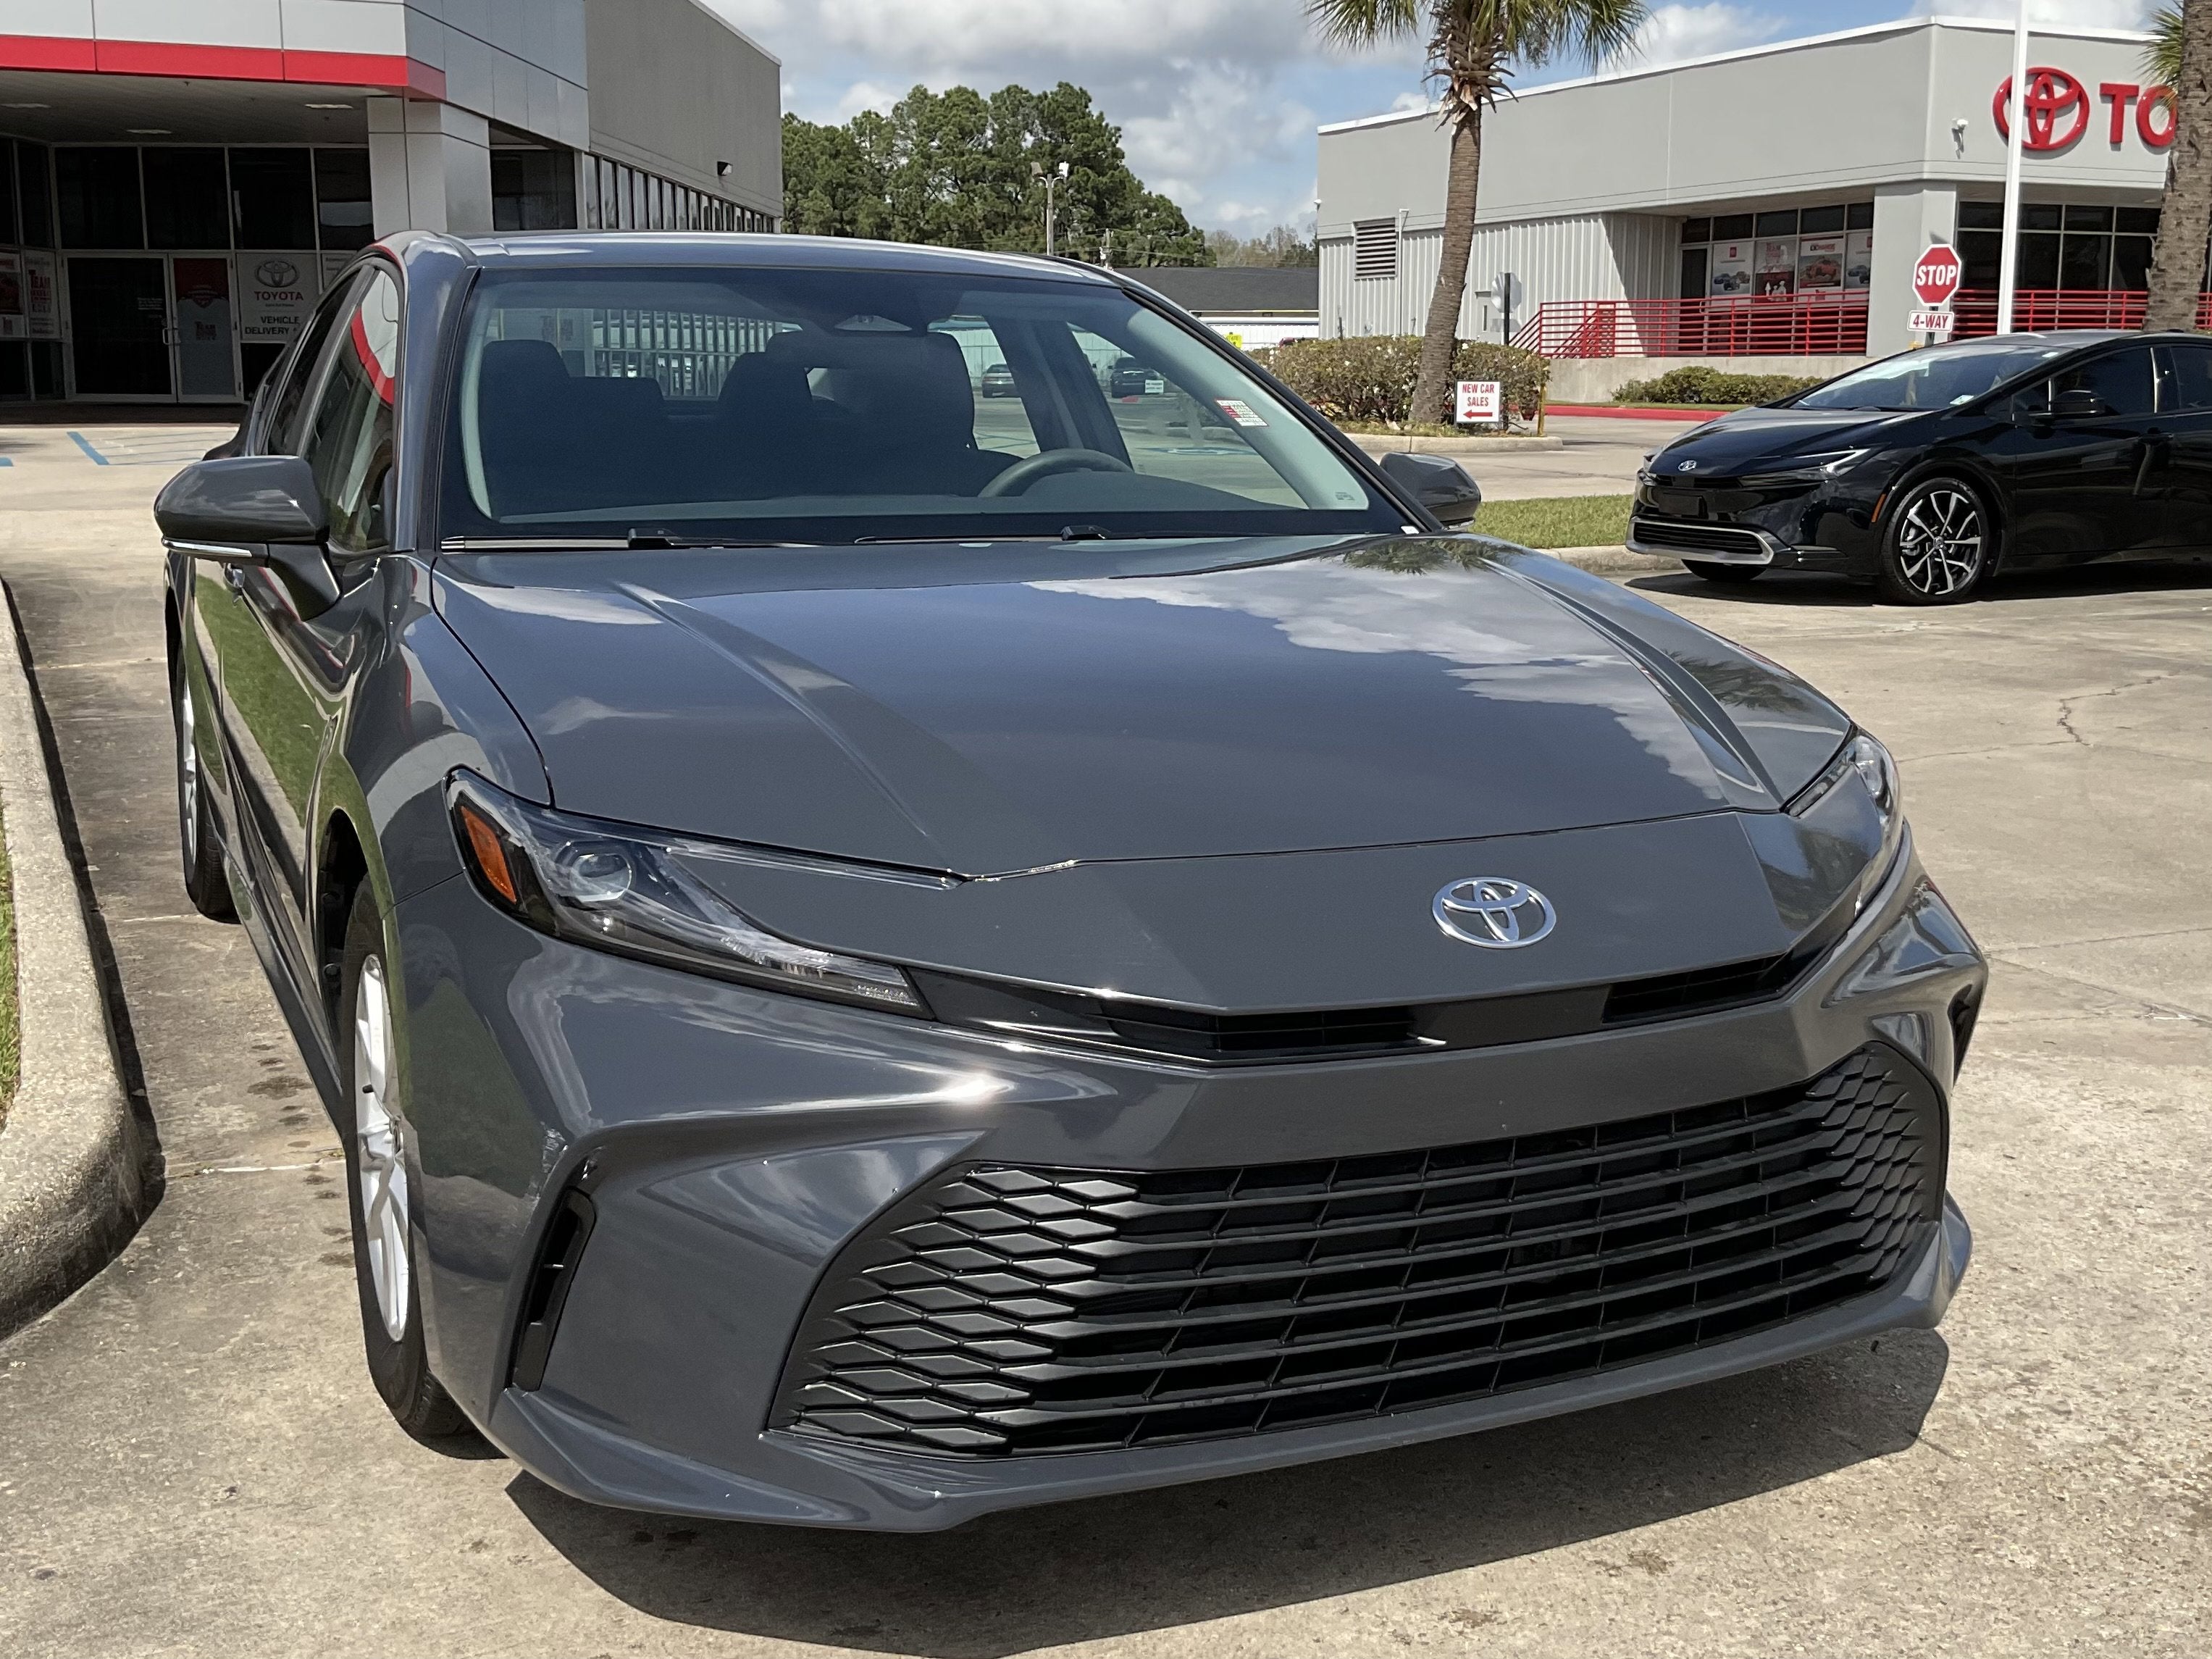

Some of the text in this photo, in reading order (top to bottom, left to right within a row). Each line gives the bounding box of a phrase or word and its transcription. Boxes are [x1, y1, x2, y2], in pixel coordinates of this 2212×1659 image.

[1916, 264, 1957, 286] STOP
[254, 291, 303, 301] TOYOTA
[261, 316, 300, 325] VEHICLE
[1913, 314, 1948, 329] 4-WAY
[1462, 383, 1495, 393] NEW CAR
[1467, 396, 1489, 406] SALES
